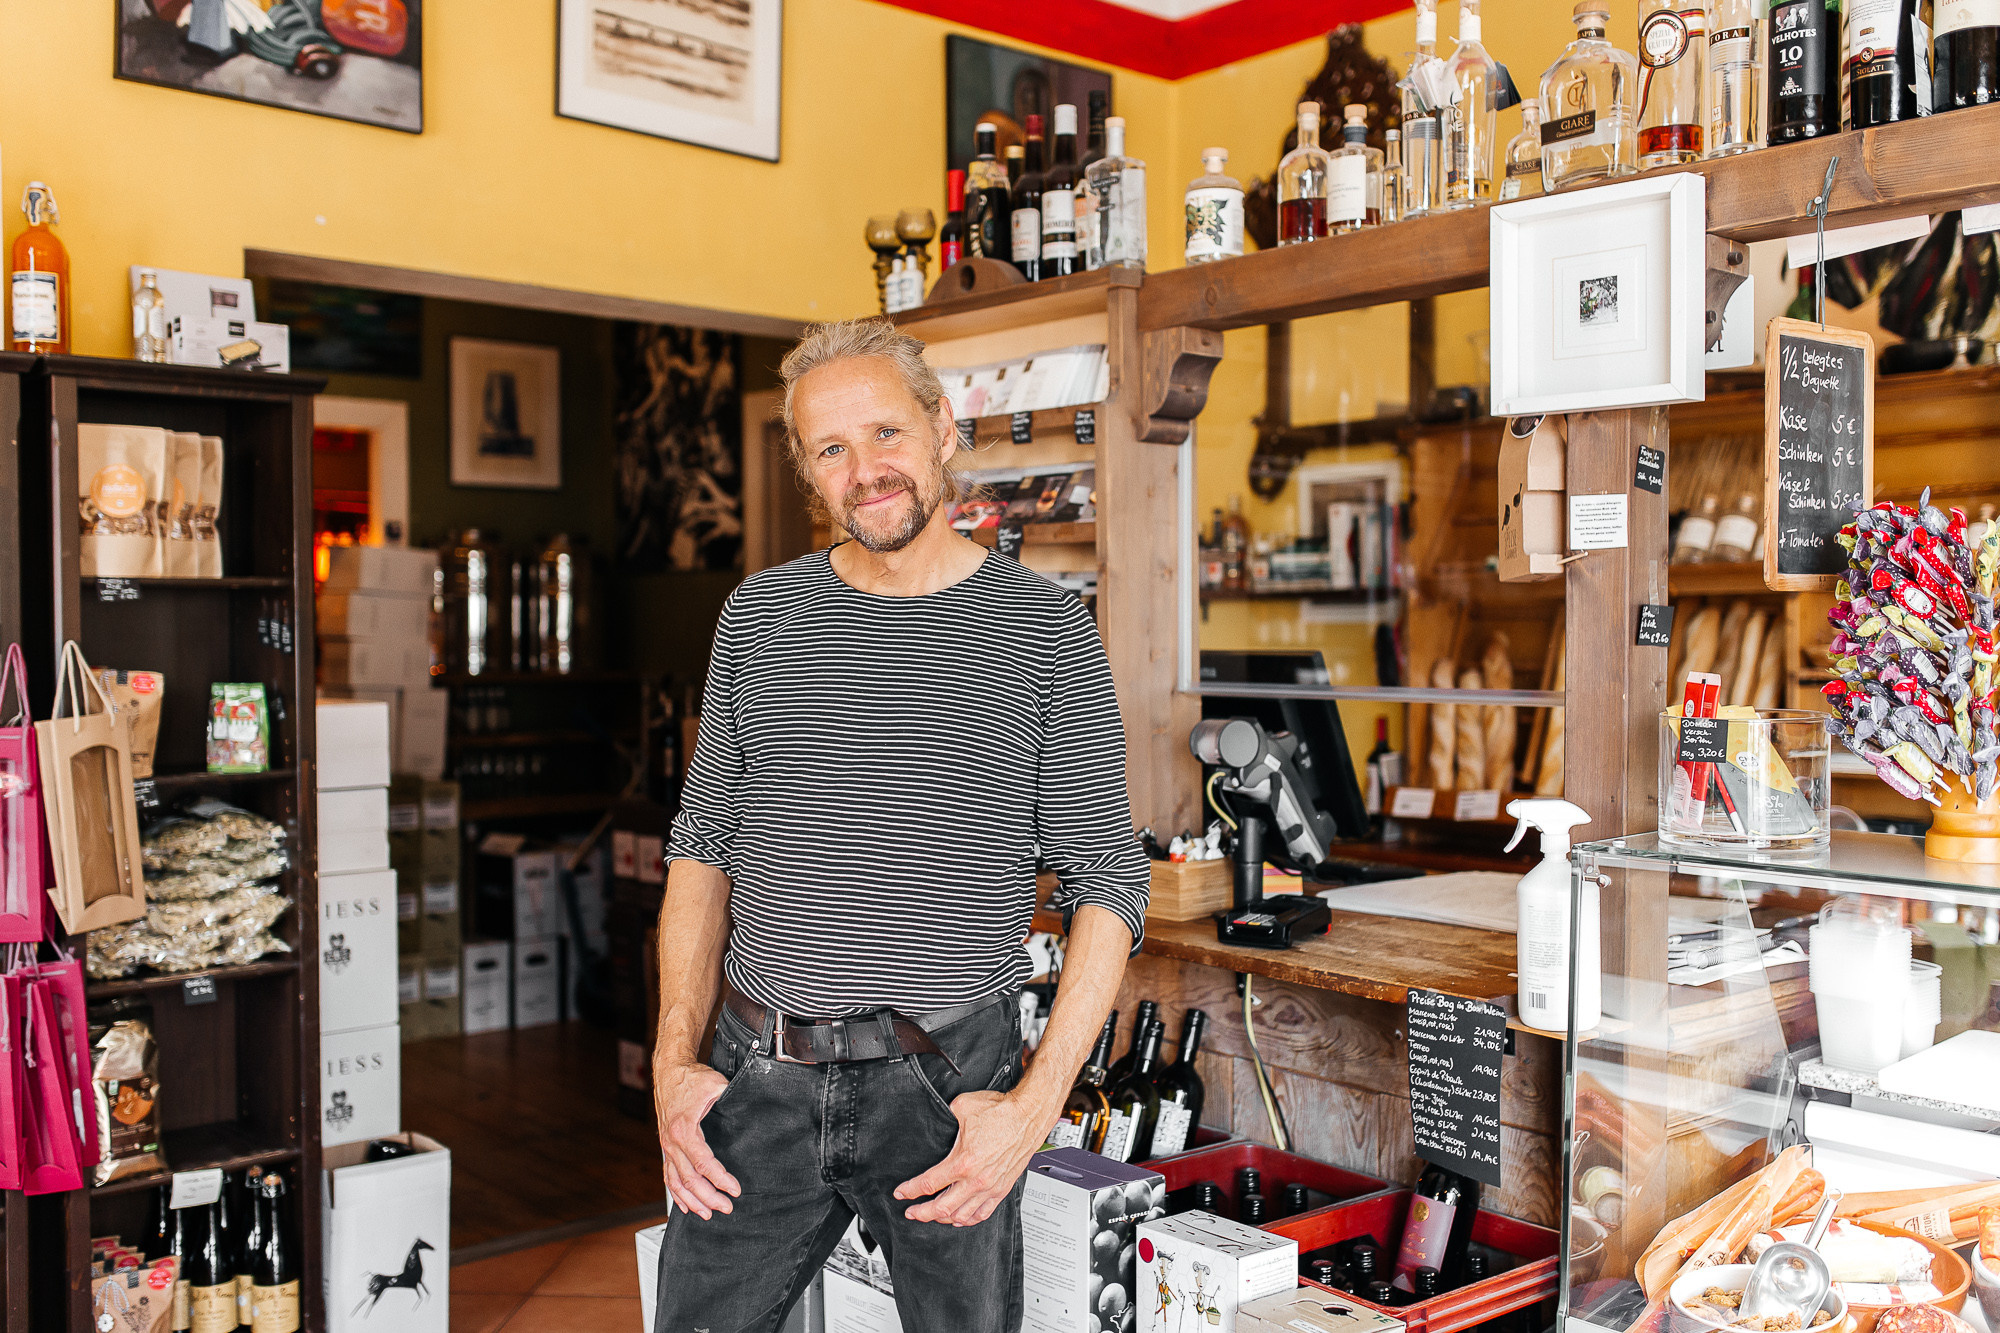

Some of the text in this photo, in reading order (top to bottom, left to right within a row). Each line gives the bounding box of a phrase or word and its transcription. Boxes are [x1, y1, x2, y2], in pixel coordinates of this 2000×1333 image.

[1772, 28, 1817, 45] VELHOTES
[1780, 45, 1803, 64] 10
[1560, 114, 1590, 131] GIARE
[1782, 344, 1844, 381] 1/2 belegtes
[1801, 366, 1840, 394] Baguette
[1780, 405, 1856, 435] Käse 5 €
[1779, 439, 1856, 467] Schinken 5 €
[1779, 471, 1803, 492] Käse
[1788, 493, 1826, 510] Schinken
[1787, 528, 1824, 548] Tomaten
[1682, 719, 1717, 729] DOMORI
[1408, 991, 1436, 1006] Preise
[1436, 995, 1454, 1012] Bag
[1457, 1001, 1464, 1010] in
[1483, 1004, 1506, 1018] Weine
[1108, 1214, 1128, 1224] ESPRIT
